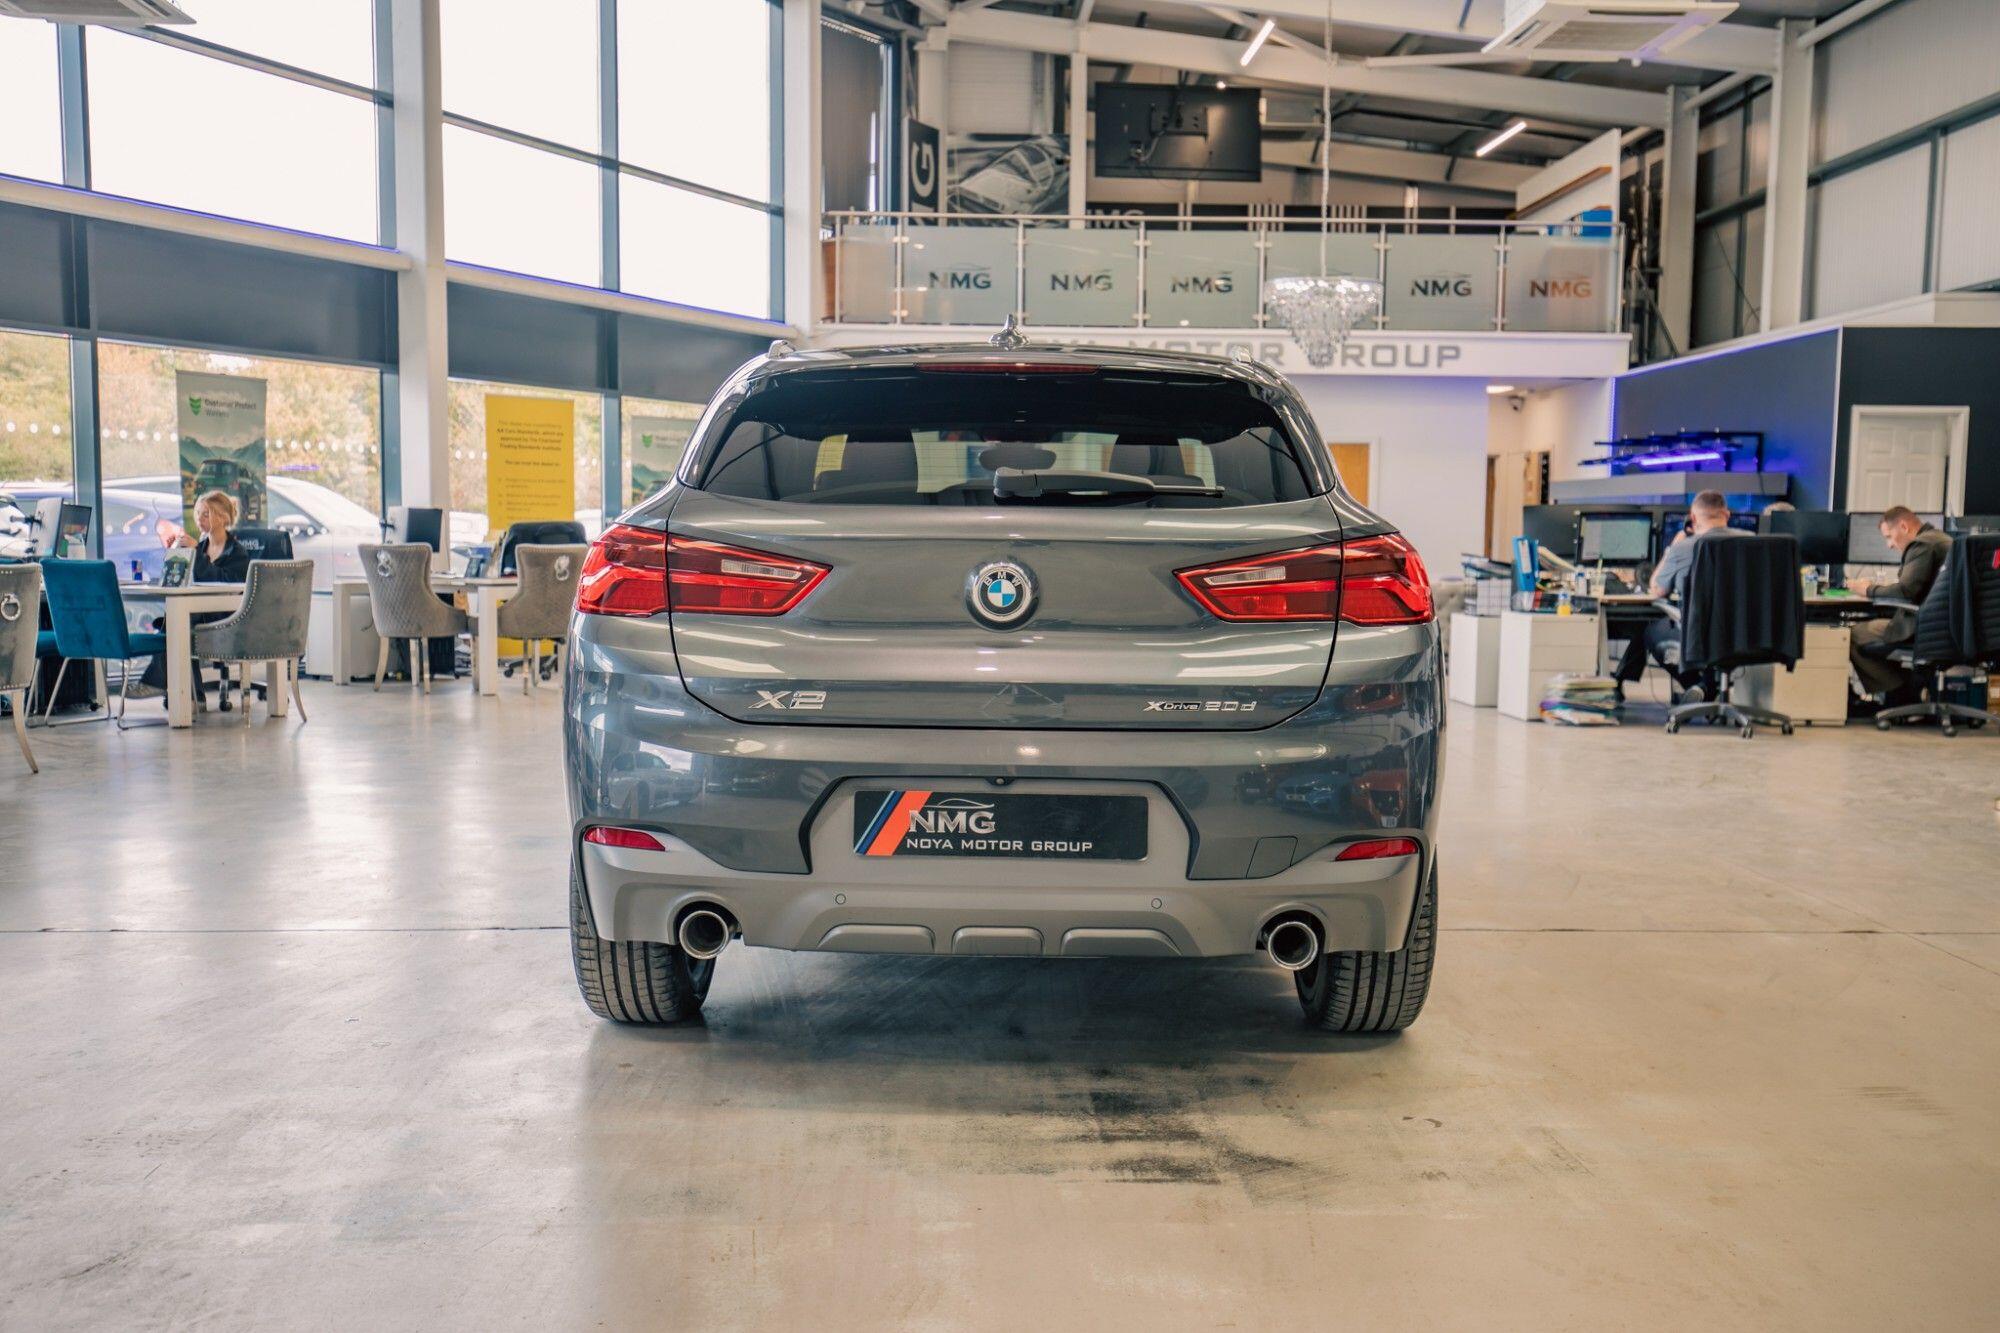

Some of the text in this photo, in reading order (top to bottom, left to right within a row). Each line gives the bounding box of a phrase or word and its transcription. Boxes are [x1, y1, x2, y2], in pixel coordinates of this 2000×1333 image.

[929, 272, 992, 289] NMG
[1051, 274, 1112, 291] NMG
[1171, 276, 1233, 293] NMG
[1411, 280, 1472, 296] NMG
[1529, 280, 1592, 298] NMG
[983, 571, 1022, 586] BMW
[748, 690, 827, 709] X2
[909, 810, 996, 834] NMG
[906, 838, 1093, 852] NOYA MOTOR GROUP
